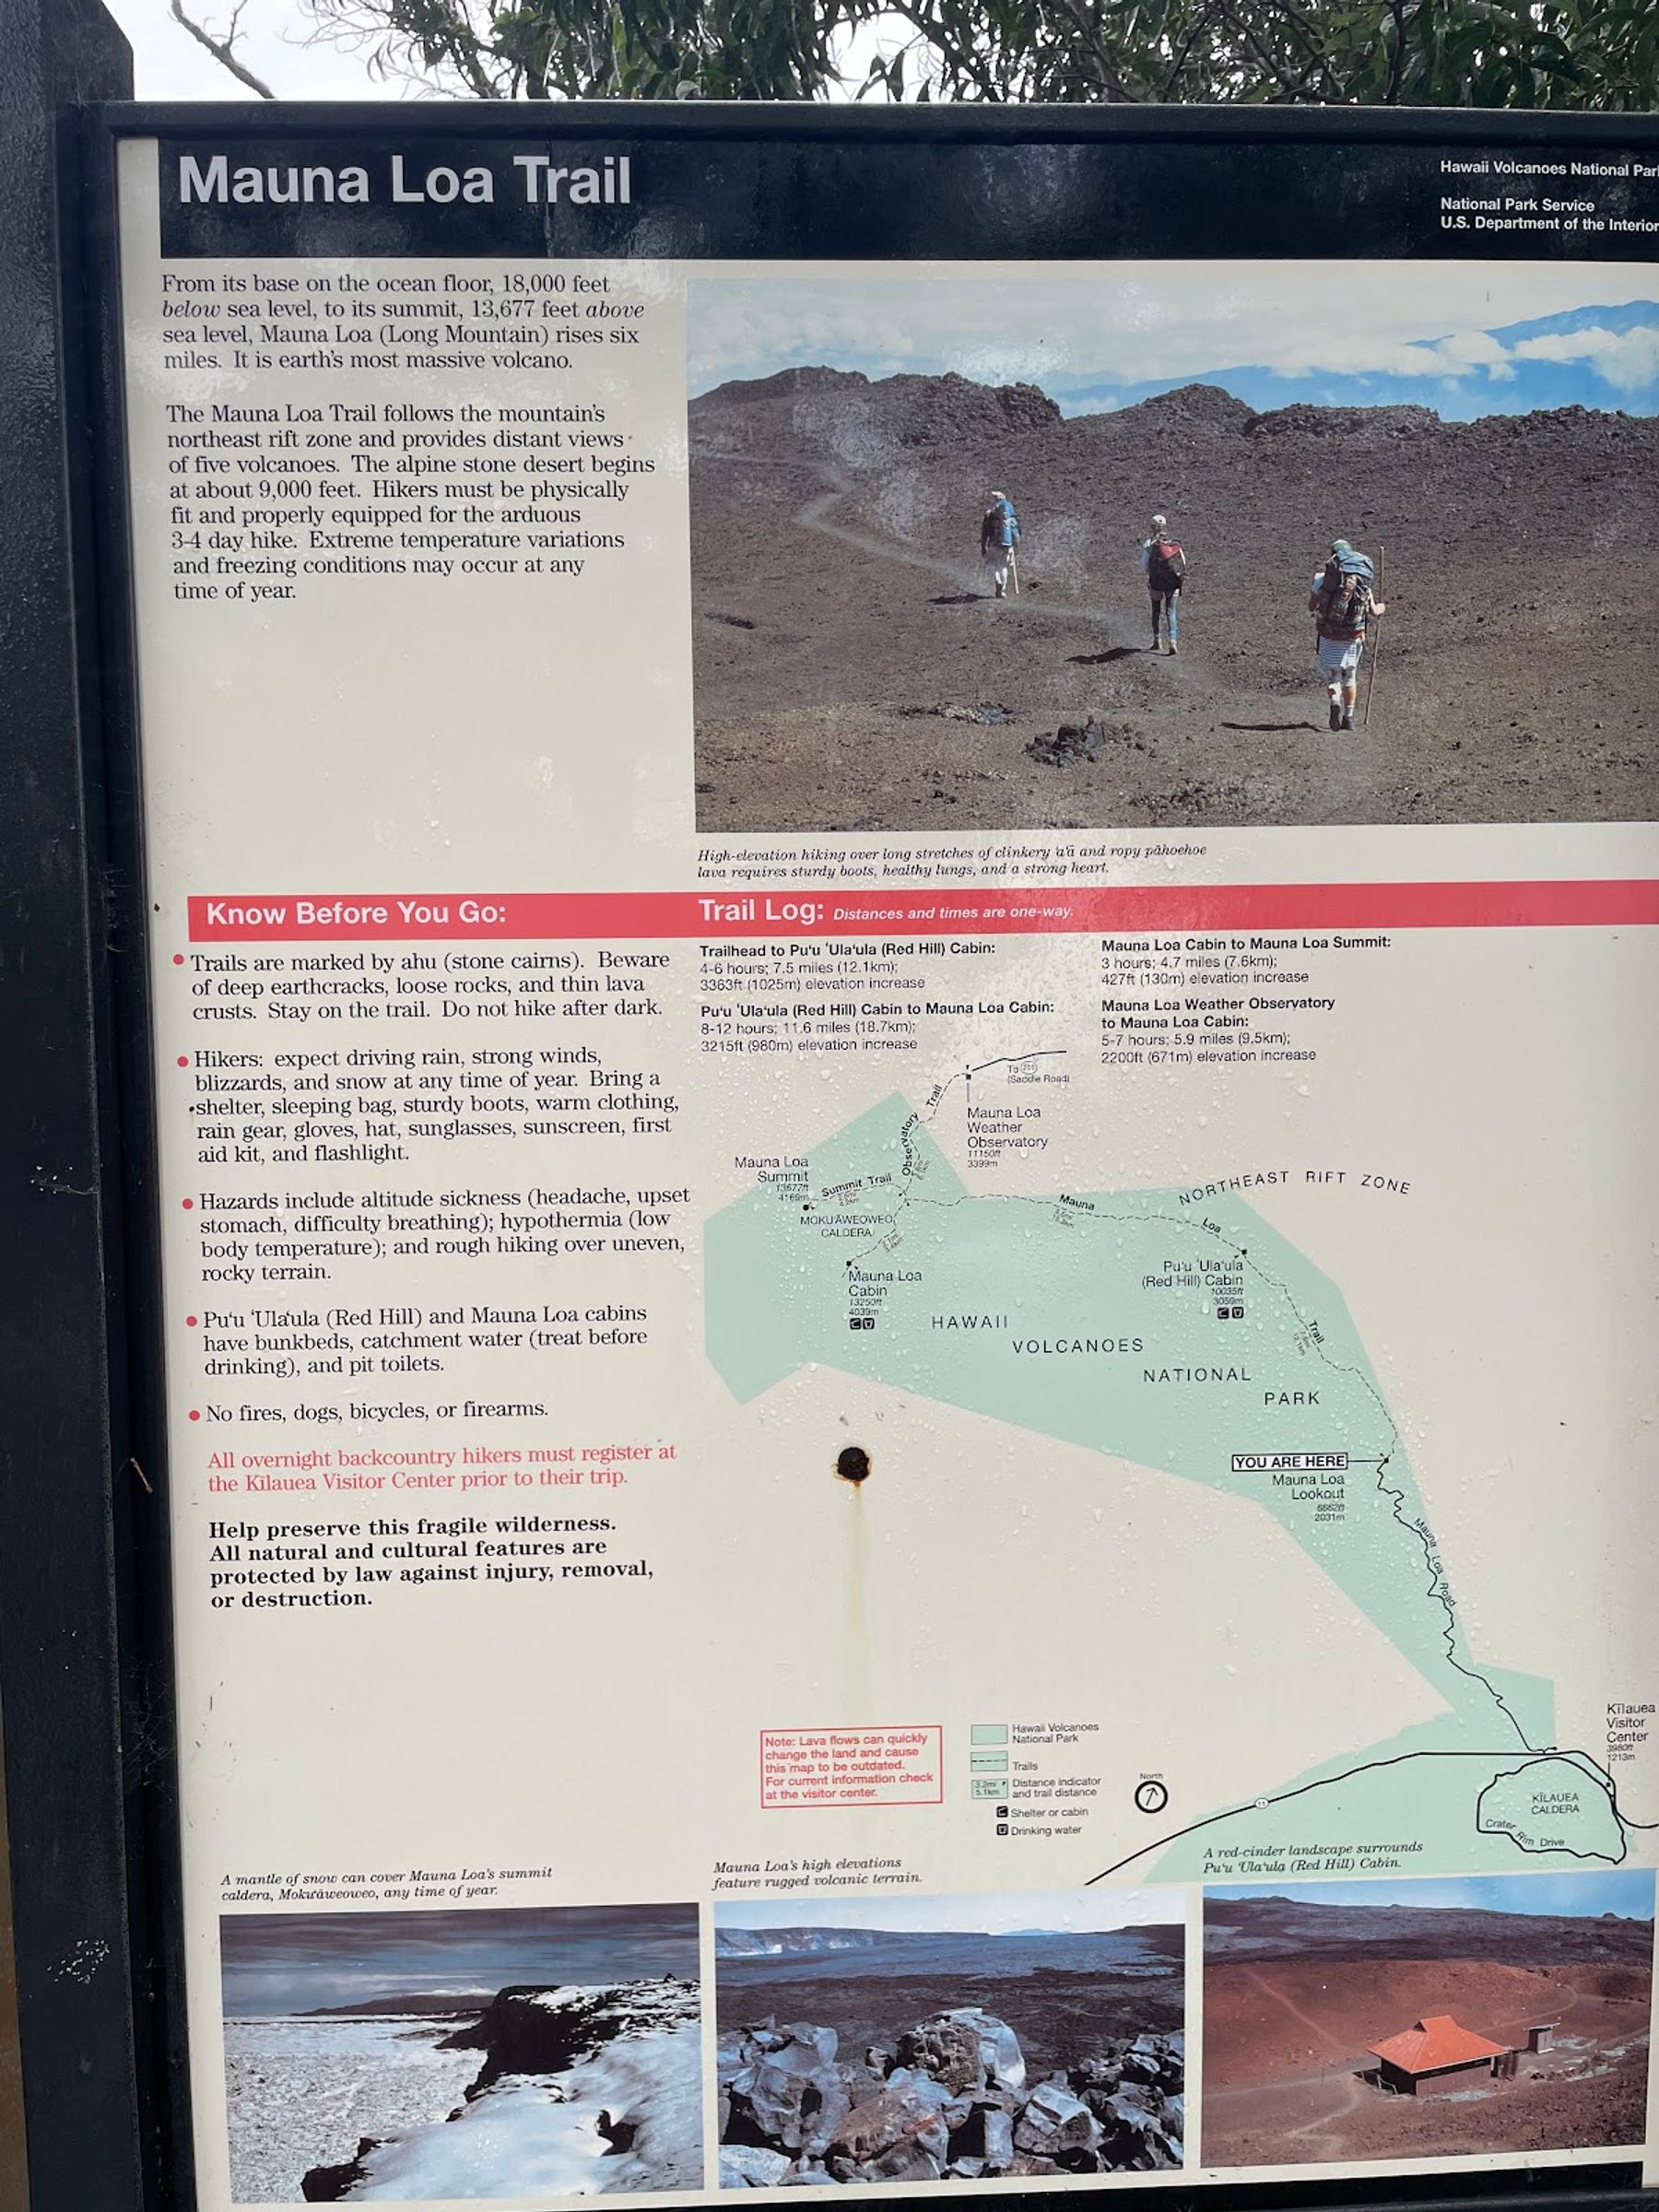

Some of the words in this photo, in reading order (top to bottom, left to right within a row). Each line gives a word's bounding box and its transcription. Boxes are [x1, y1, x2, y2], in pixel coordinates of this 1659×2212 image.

[1441, 160, 1488, 173] Hawaii
[1493, 161, 1567, 175] Volcanoes
[1571, 162, 1629, 176] National
[180, 156, 369, 203] Mauna
[392, 155, 494, 203] Loa
[513, 156, 629, 204] Trail
[1441, 197, 1500, 210] National
[1506, 198, 1537, 210] Park
[1542, 198, 1594, 212] Service
[1441, 216, 1470, 229] U.S.
[1476, 217, 1559, 231] Department
[1564, 218, 1578, 229] of
[1583, 218, 1605, 230] the
[1609, 218, 1659, 231] Interior
[162, 275, 215, 292] From
[223, 275, 246, 292] its
[253, 274, 299, 291] base
[307, 279, 331, 291] on
[338, 274, 370, 291] the
[377, 279, 436, 291] ocean
[443, 274, 493, 296] floor,
[504, 274, 565, 296] 18,000
[573, 275, 610, 292] feet
[166, 406, 204, 422] The
[212, 405, 279, 422] Mauna
[286, 405, 324, 422] Loa
[329, 405, 376, 421] Trail
[383, 405, 453, 422] follows
[461, 405, 491, 422] the
[699, 866, 726, 877] lava
[732, 865, 787, 880] requires
[791, 865, 836, 878] sturdy
[841, 865, 877, 878] boots,
[883, 865, 932, 878] healthy
[936, 864, 975, 877] lungs,
[982, 863, 1007, 875] and
[1011, 865, 1019, 875] a
[1024, 864, 1066, 876] strong
[1072, 862, 1108, 873] heart.
[207, 903, 286, 924] Know
[297, 902, 387, 924] Before
[397, 901, 448, 923] You
[459, 900, 505, 923] Go:
[699, 899, 754, 921] Trail
[766, 899, 823, 925] Log:
[833, 909, 903, 920] Distances
[908, 907, 935, 919] and
[940, 907, 978, 919] times
[982, 909, 1006, 918] are
[1010, 907, 1073, 919] one-way.
[1102, 940, 1149, 951] Mauna
[1155, 939, 1180, 950] Loa
[1186, 938, 1226, 950] Cabin
[1231, 939, 1245, 949] to
[1251, 938, 1297, 949] Mauna
[1303, 937, 1328, 948] Loa
[1334, 936, 1390, 947] Summit:
[700, 979, 742, 991] 3363ft
[748, 978, 800, 994] (1025m)
[806, 978, 865, 989] elevation
[870, 977, 924, 988] increase
[194, 1051, 262, 1067] Hikers:
[275, 1052, 338, 1070] expect
[347, 1050, 416, 1069] driving
[423, 1048, 465, 1067] rain,
[473, 1050, 533, 1068] strong
[540, 1047, 601, 1066] winds,
[968, 1108, 1012, 1118] Mauna
[1017, 1107, 1041, 1118] Loa
[968, 1122, 1022, 1133] Weather
[901, 1112, 919, 1175] Observatory
[968, 1136, 1048, 1149] Observatory
[735, 1157, 779, 1168] Mauna
[784, 1157, 808, 1167] Loa
[758, 1171, 808, 1182] Summit
[822, 1180, 862, 1197] Summit
[868, 1173, 891, 1184] Trail
[1179, 1171, 1289, 1206] NORTHEAST
[1306, 1171, 1346, 1183] RIFT
[1361, 1174, 1411, 1194] ZONE
[200, 1193, 278, 1209] Hazards
[286, 1192, 354, 1208] include
[361, 1191, 433, 1207] altitude
[440, 1190, 521, 1206] sickness
[528, 1188, 629, 1209] (headache,
[634, 1188, 690, 1211] upset
[849, 1272, 893, 1282] Mauna
[899, 1270, 922, 1281] Loa
[849, 1286, 887, 1297] Cabin
[932, 1315, 1008, 1329] HAWAII
[1012, 1338, 1144, 1354] VOLCANOES
[1144, 1368, 1252, 1382] NATIONAL
[1265, 1391, 1320, 1406] PARK
[206, 1406, 232, 1421] No
[240, 1405, 286, 1424] fires,
[294, 1404, 342, 1423] dogs,
[350, 1402, 429, 1422] bicycles,
[437, 1406, 457, 1418] or
[465, 1401, 547, 1417] firearms.
[208, 1452, 235, 1468] All
[242, 1451, 332, 1470] overnight
[338, 1449, 455, 1467] backcountry
[463, 1447, 522, 1464] hikers
[528, 1447, 575, 1462] must
[582, 1445, 653, 1465] register
[658, 1445, 677, 1459] at
[1236, 1457, 1266, 1468] YOU
[1271, 1456, 1300, 1467] ARE
[1306, 1456, 1345, 1466] HERE
[1273, 1475, 1315, 1486] Mauna
[1321, 1474, 1345, 1484] Loa
[1292, 1488, 1344, 1500] Lookout
[209, 1523, 259, 1541] Help
[267, 1524, 360, 1541] preserve
[369, 1519, 408, 1535] this
[418, 1518, 487, 1536] fragile
[496, 1516, 616, 1533] wilderness.
[1013, 1724, 1045, 1733] Hawaii
[1048, 1724, 1099, 1732] Volcanoes
[1607, 1718, 1645, 1728] Visitor
[766, 1737, 795, 1747] Note:
[799, 1736, 826, 1746] Lava
[830, 1735, 860, 1745] flows
[888, 1733, 927, 1746] quickly
[1013, 1735, 1053, 1743] National
[1056, 1734, 1078, 1743] Park
[1606, 1732, 1648, 1743] Center
[1013, 1761, 1037, 1771] Trails
[1011, 1808, 1046, 1818] Shelter
[1062, 1807, 1088, 1816] cabin
[1532, 1805, 1579, 1815] CALDERA
[1011, 1827, 1052, 1837] Drinking
[1054, 1826, 1082, 1834] water
[1204, 1848, 1213, 1858] A
[1218, 1846, 1286, 1857] red-cinder
[1288, 1845, 1352, 1857] landscape
[1357, 1841, 1423, 1853] surrounds
[713, 1862, 759, 1874] Mauna
[803, 1859, 830, 1873] high
[836, 1857, 901, 1869] elevations
